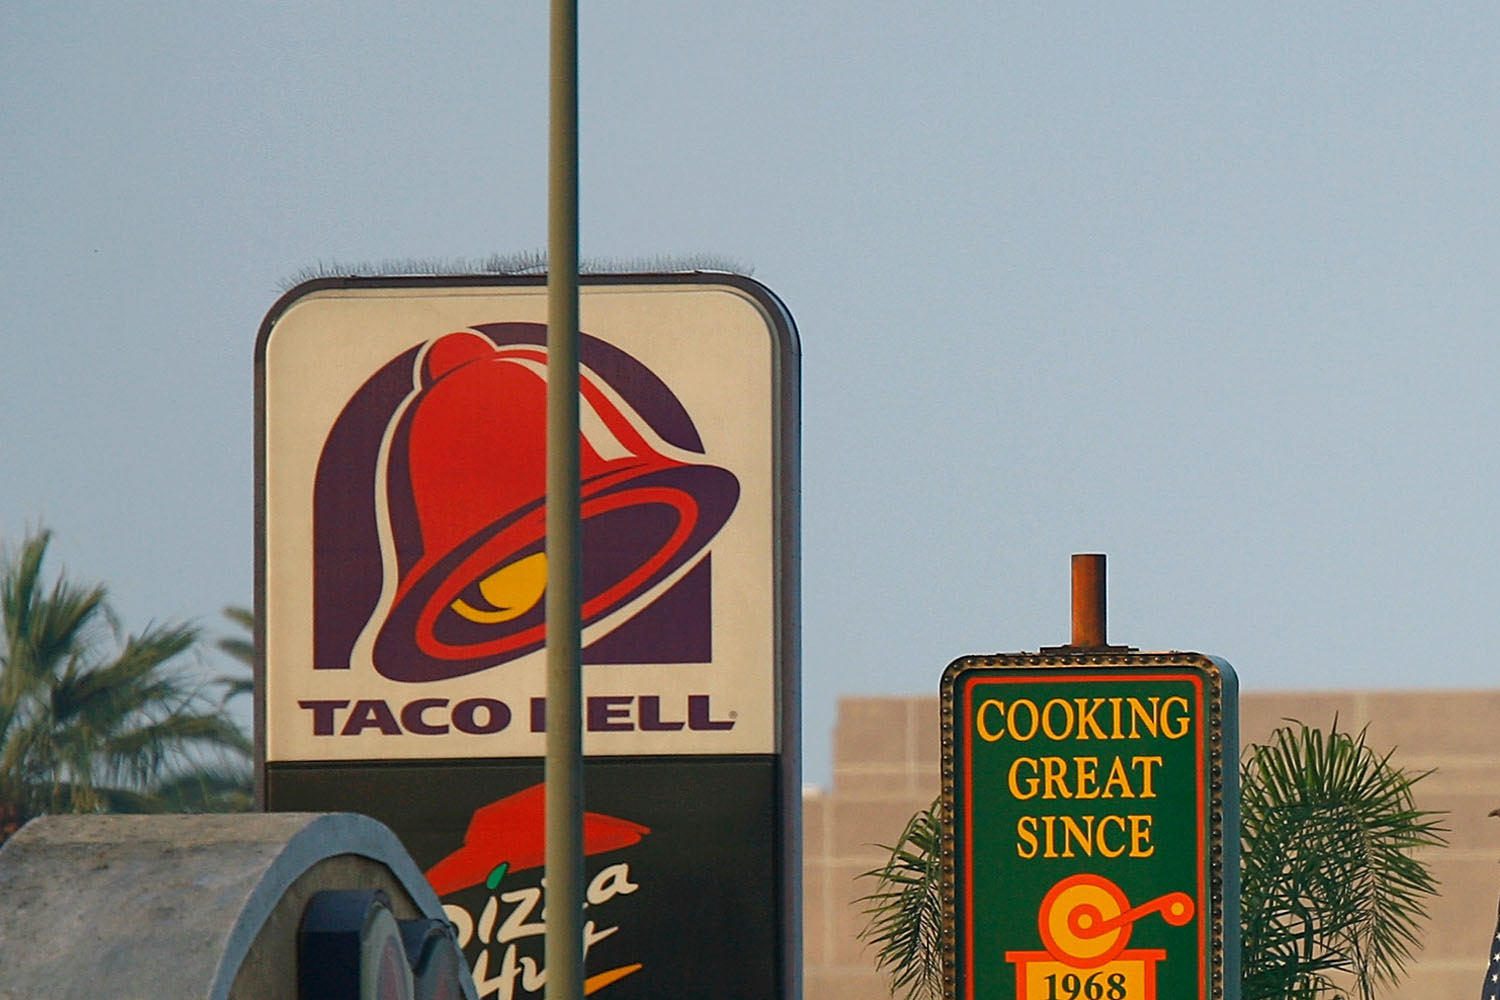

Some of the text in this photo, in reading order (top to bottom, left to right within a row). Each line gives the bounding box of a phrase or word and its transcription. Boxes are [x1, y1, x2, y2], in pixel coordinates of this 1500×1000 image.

[299, 697, 512, 736] TACO
[977, 697, 1190, 741] COOKING
[1008, 756, 1162, 800] GREAT
[1016, 814, 1155, 858] SINCE
